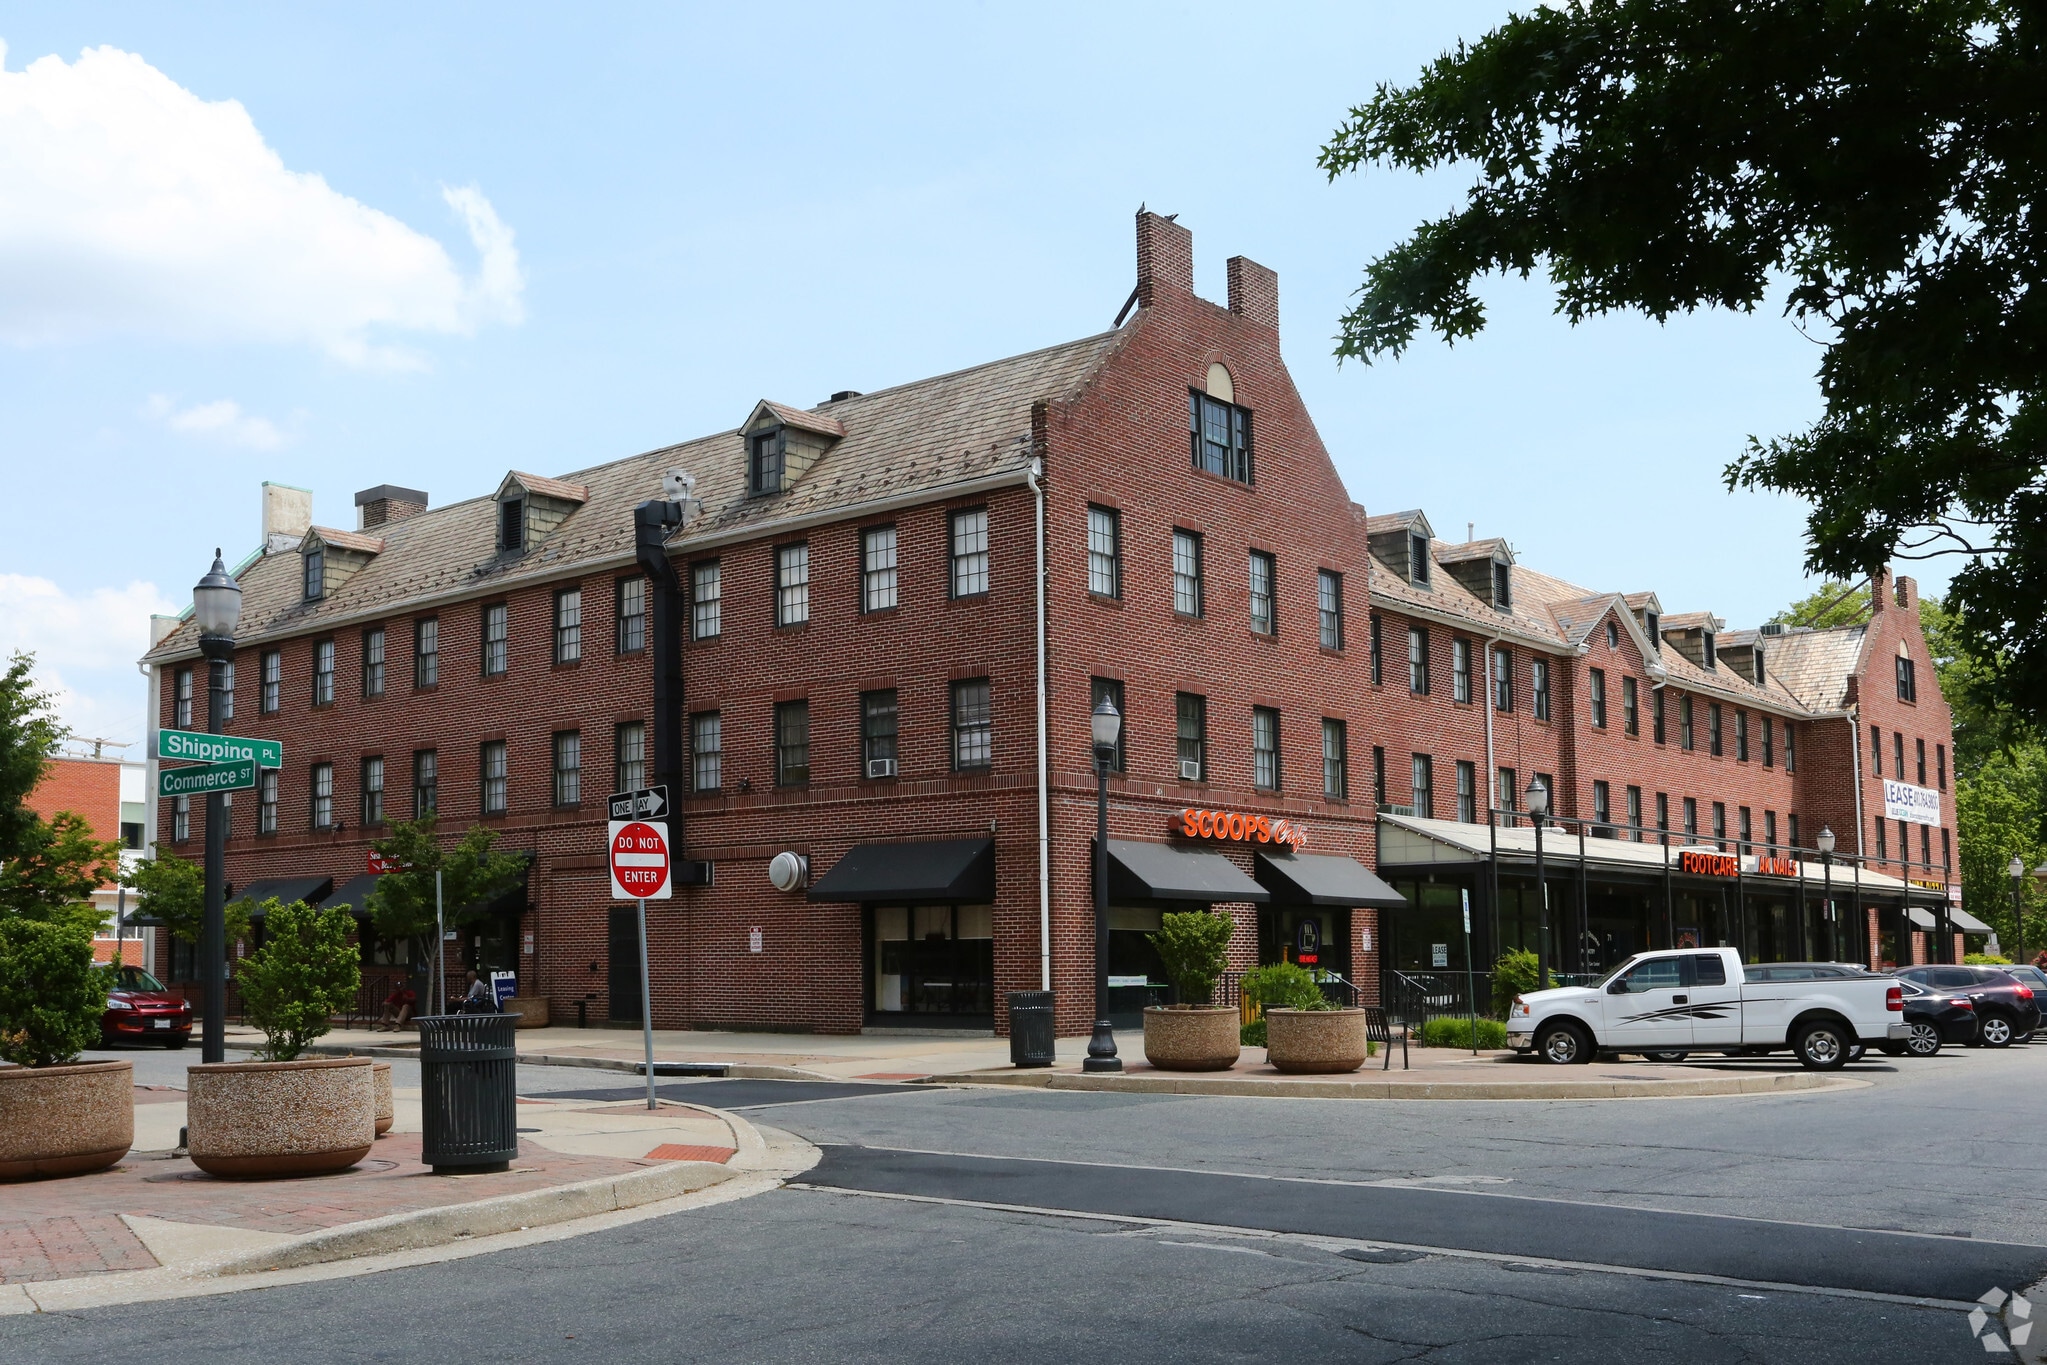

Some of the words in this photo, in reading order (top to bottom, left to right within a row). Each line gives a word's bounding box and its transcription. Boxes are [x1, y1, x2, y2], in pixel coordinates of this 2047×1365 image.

[168, 735, 253, 760] Shipping
[263, 748, 276, 759] PL
[164, 770, 236, 791] Commerce
[241, 768, 251, 779] ST
[1885, 783, 1913, 806] LEASE
[614, 802, 630, 815] ONE
[634, 798, 649, 811] AY
[1183, 808, 1271, 843] SCOOPS
[619, 837, 633, 849] DO
[639, 837, 659, 850] NOT
[1683, 851, 1739, 877] FOOTCARE
[1759, 855, 1772, 874] AK
[1773, 857, 1798, 877] NAILS
[625, 871, 658, 883] ENTER
[1432, 946, 1447, 954] LEASE
